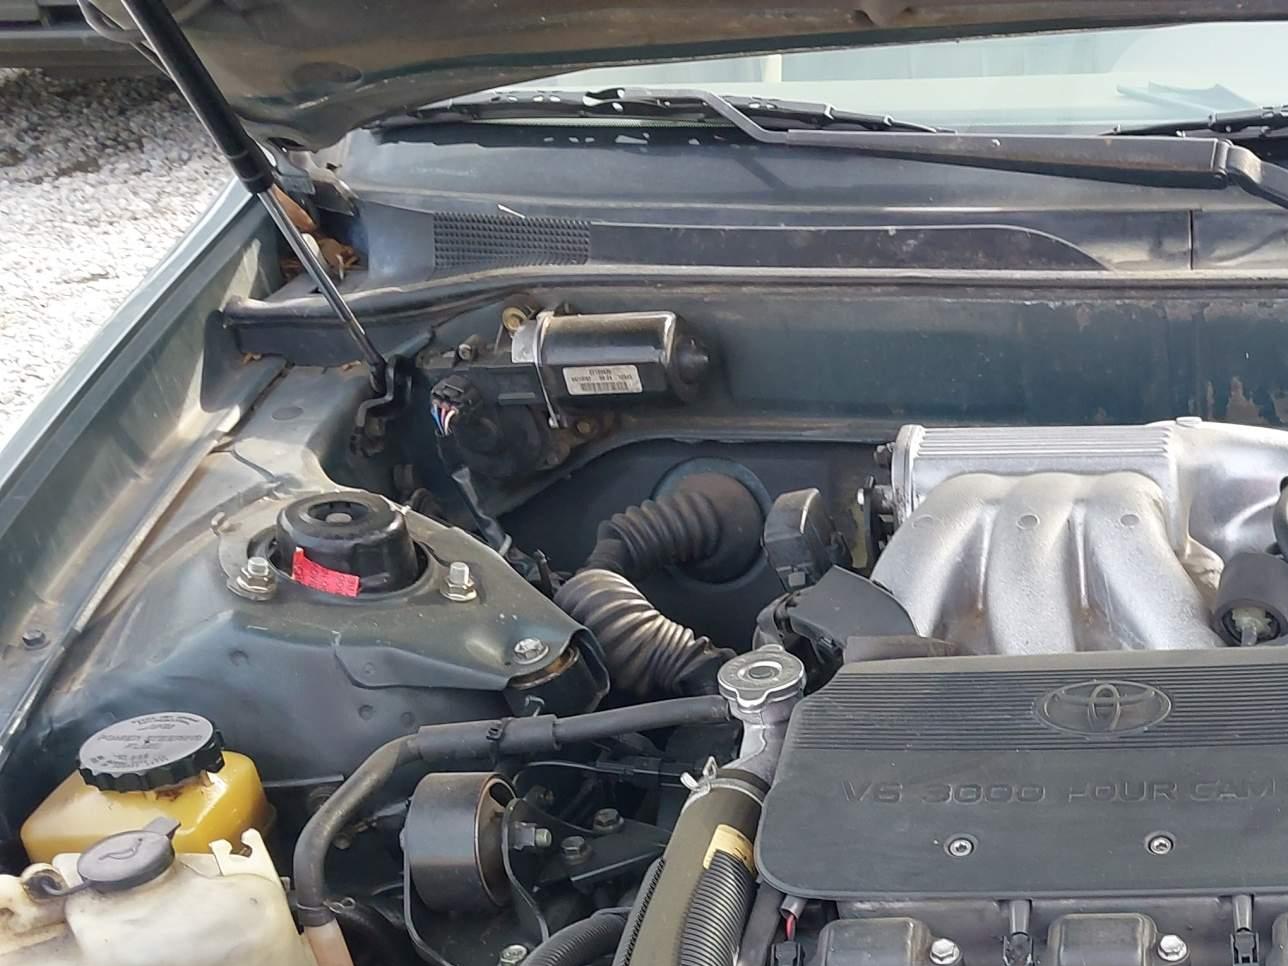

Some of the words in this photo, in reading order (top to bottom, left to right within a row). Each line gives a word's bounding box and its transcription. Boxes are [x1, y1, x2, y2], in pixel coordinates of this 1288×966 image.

[840, 782, 903, 805] V6
[922, 782, 1047, 805] 3000
[1190, 777, 1278, 801] CAM
